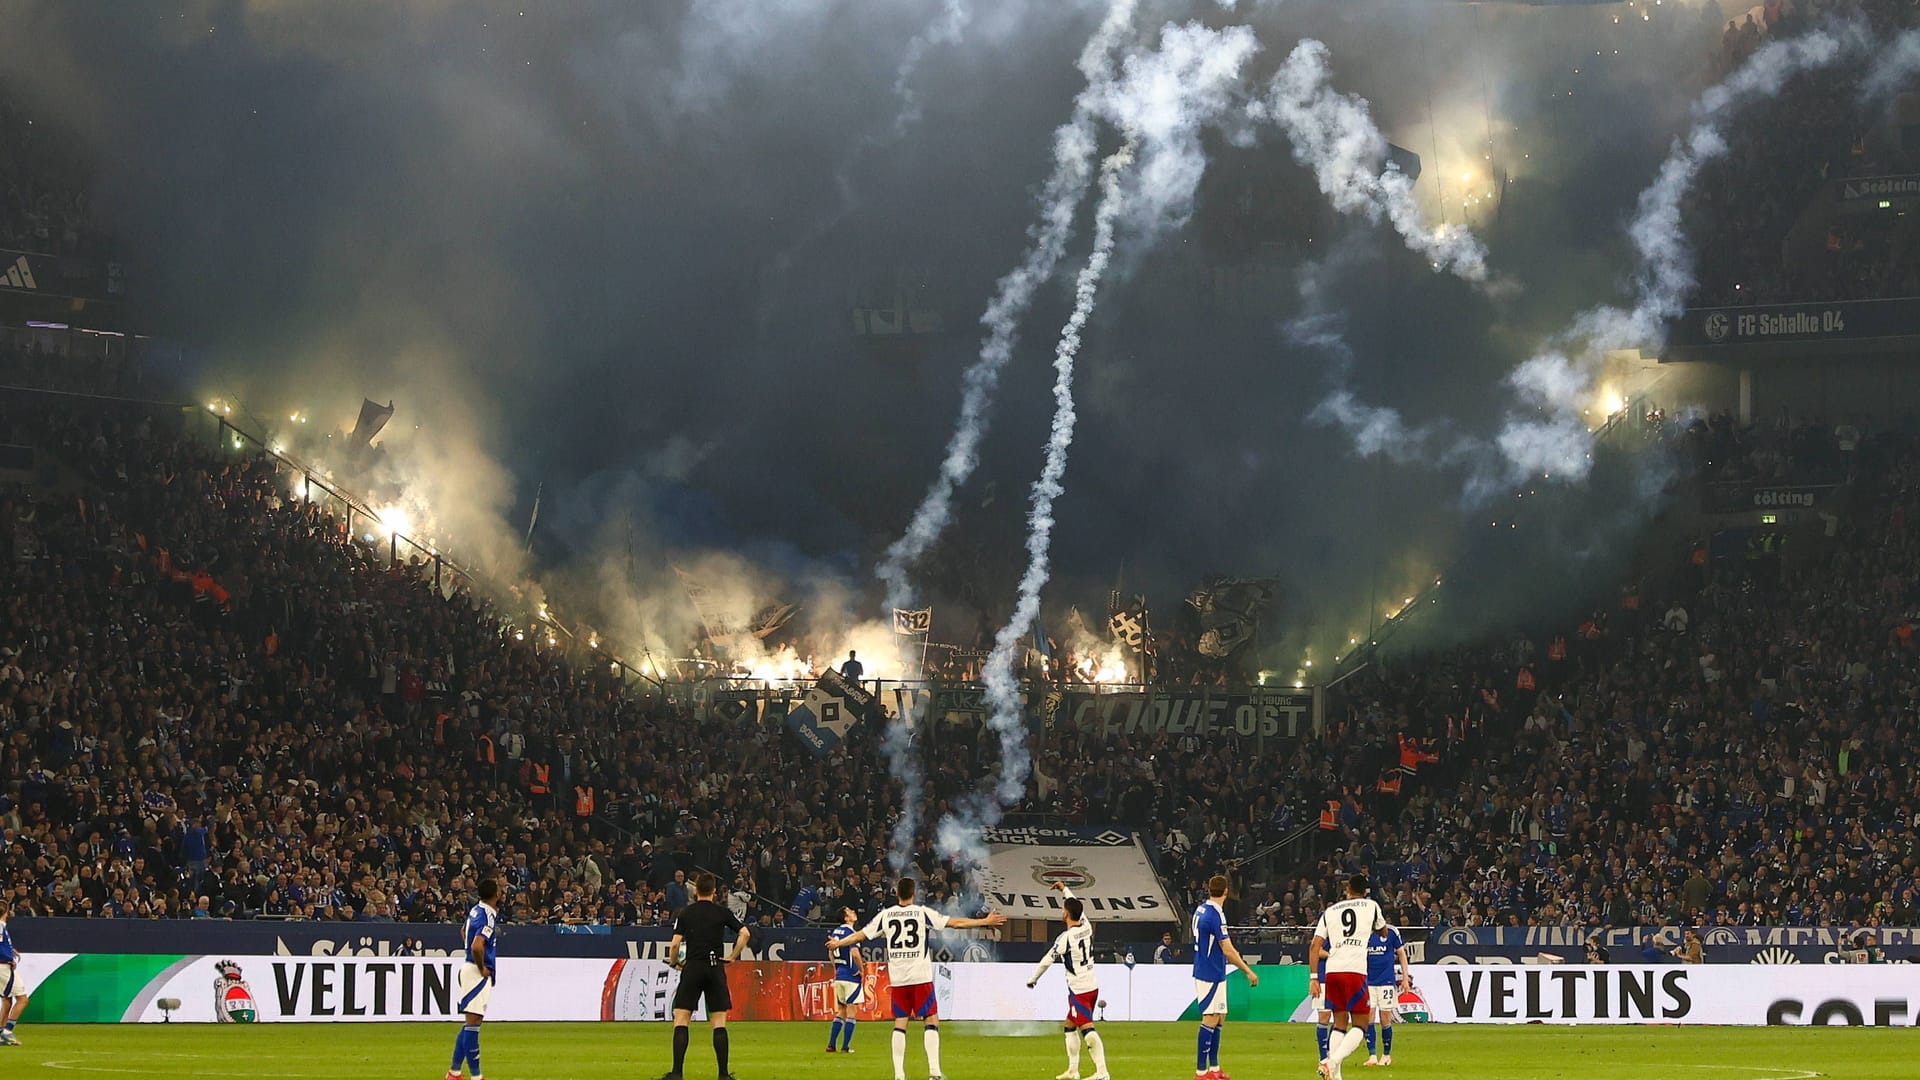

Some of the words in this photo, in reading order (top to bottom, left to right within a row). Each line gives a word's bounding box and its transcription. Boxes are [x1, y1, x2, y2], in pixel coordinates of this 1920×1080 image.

[1737, 315, 1755, 336] FC
[1759, 313, 1819, 335] Schalke
[1823, 311, 1844, 333] 04
[1249, 696, 1293, 706] HMBURG
[1235, 704, 1307, 737] OST
[991, 892, 1160, 911] VELINS
[888, 918, 920, 949] 23
[1341, 908, 1357, 938] 9
[272, 962, 467, 1016] VELTIN
[1383, 989, 1394, 1000] 29
[1445, 969, 1692, 1019] VELTINS
